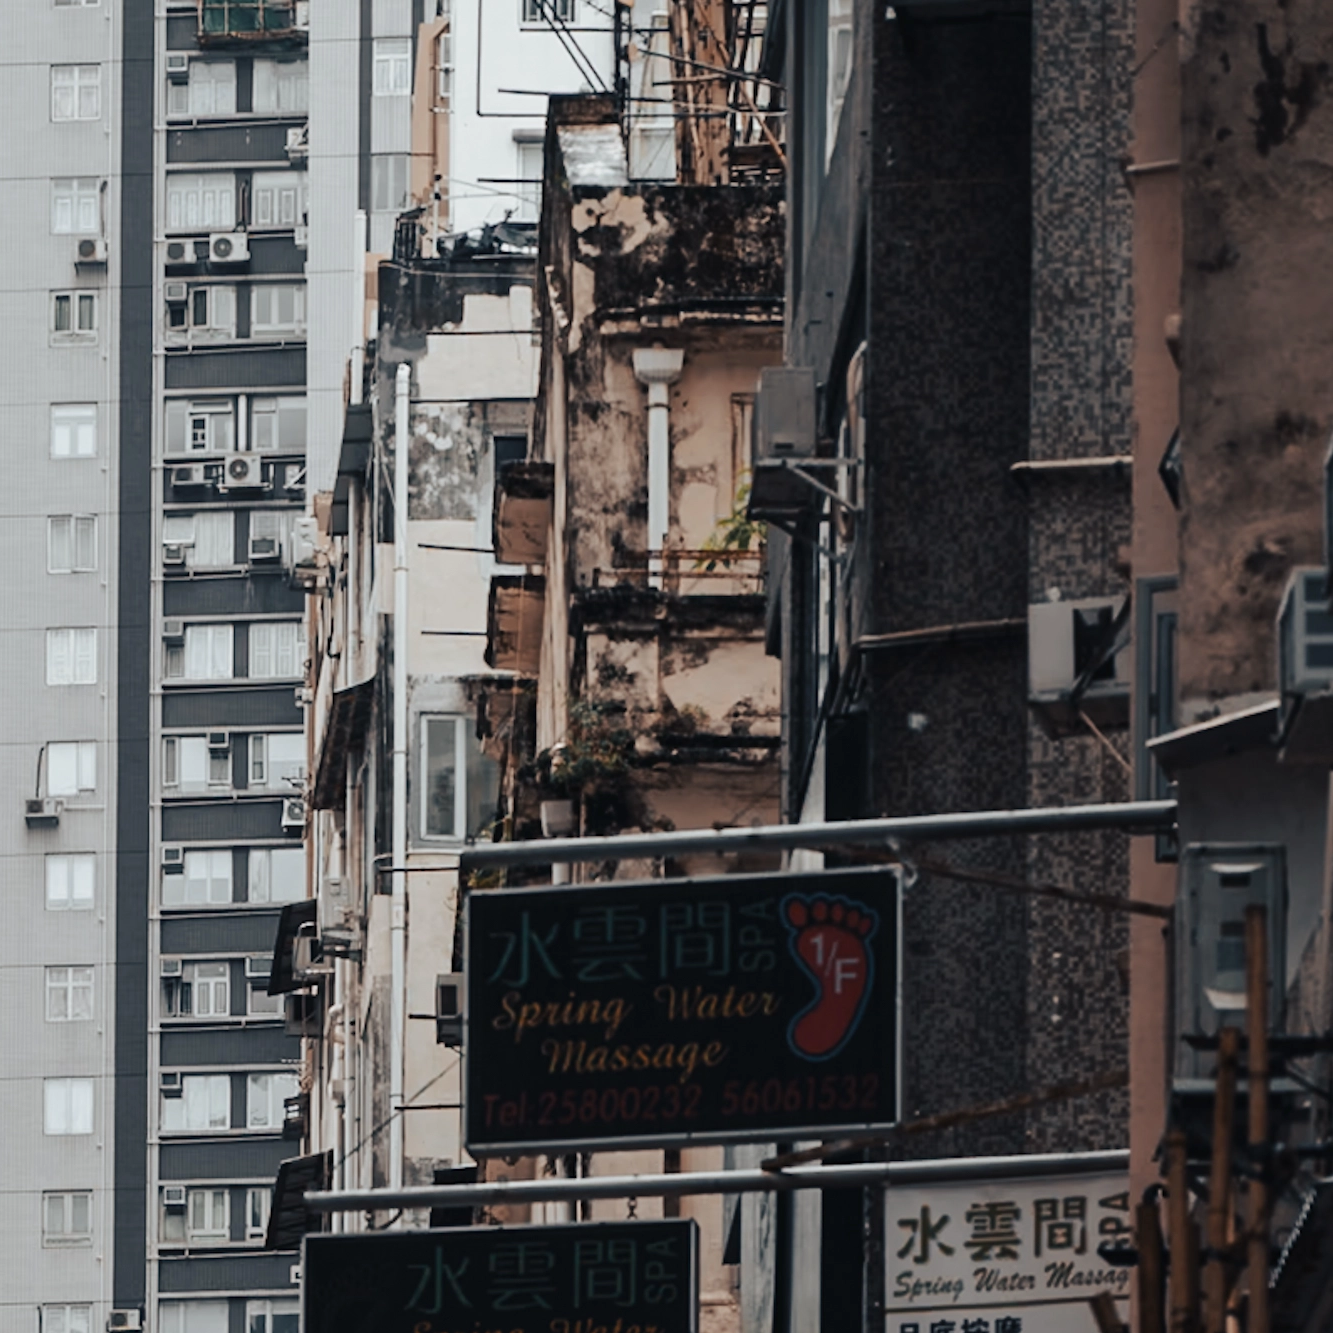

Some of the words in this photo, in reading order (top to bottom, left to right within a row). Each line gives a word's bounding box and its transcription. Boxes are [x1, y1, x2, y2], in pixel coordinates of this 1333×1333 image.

[486, 900, 732, 989] 水雲間
[738, 899, 777, 974] SPA
[810, 932, 861, 995] 1/F
[491, 989, 634, 1044] Spring
[653, 983, 783, 1023] Water
[541, 1037, 730, 1084] Massage
[721, 1073, 880, 1116] 56061532
[896, 1196, 1087, 1264] 水雲間
[403, 1238, 637, 1315] 水雲間
[643, 1236, 679, 1305] SPA
[893, 1270, 965, 1302] Spring
[973, 1267, 1037, 1293] Water
